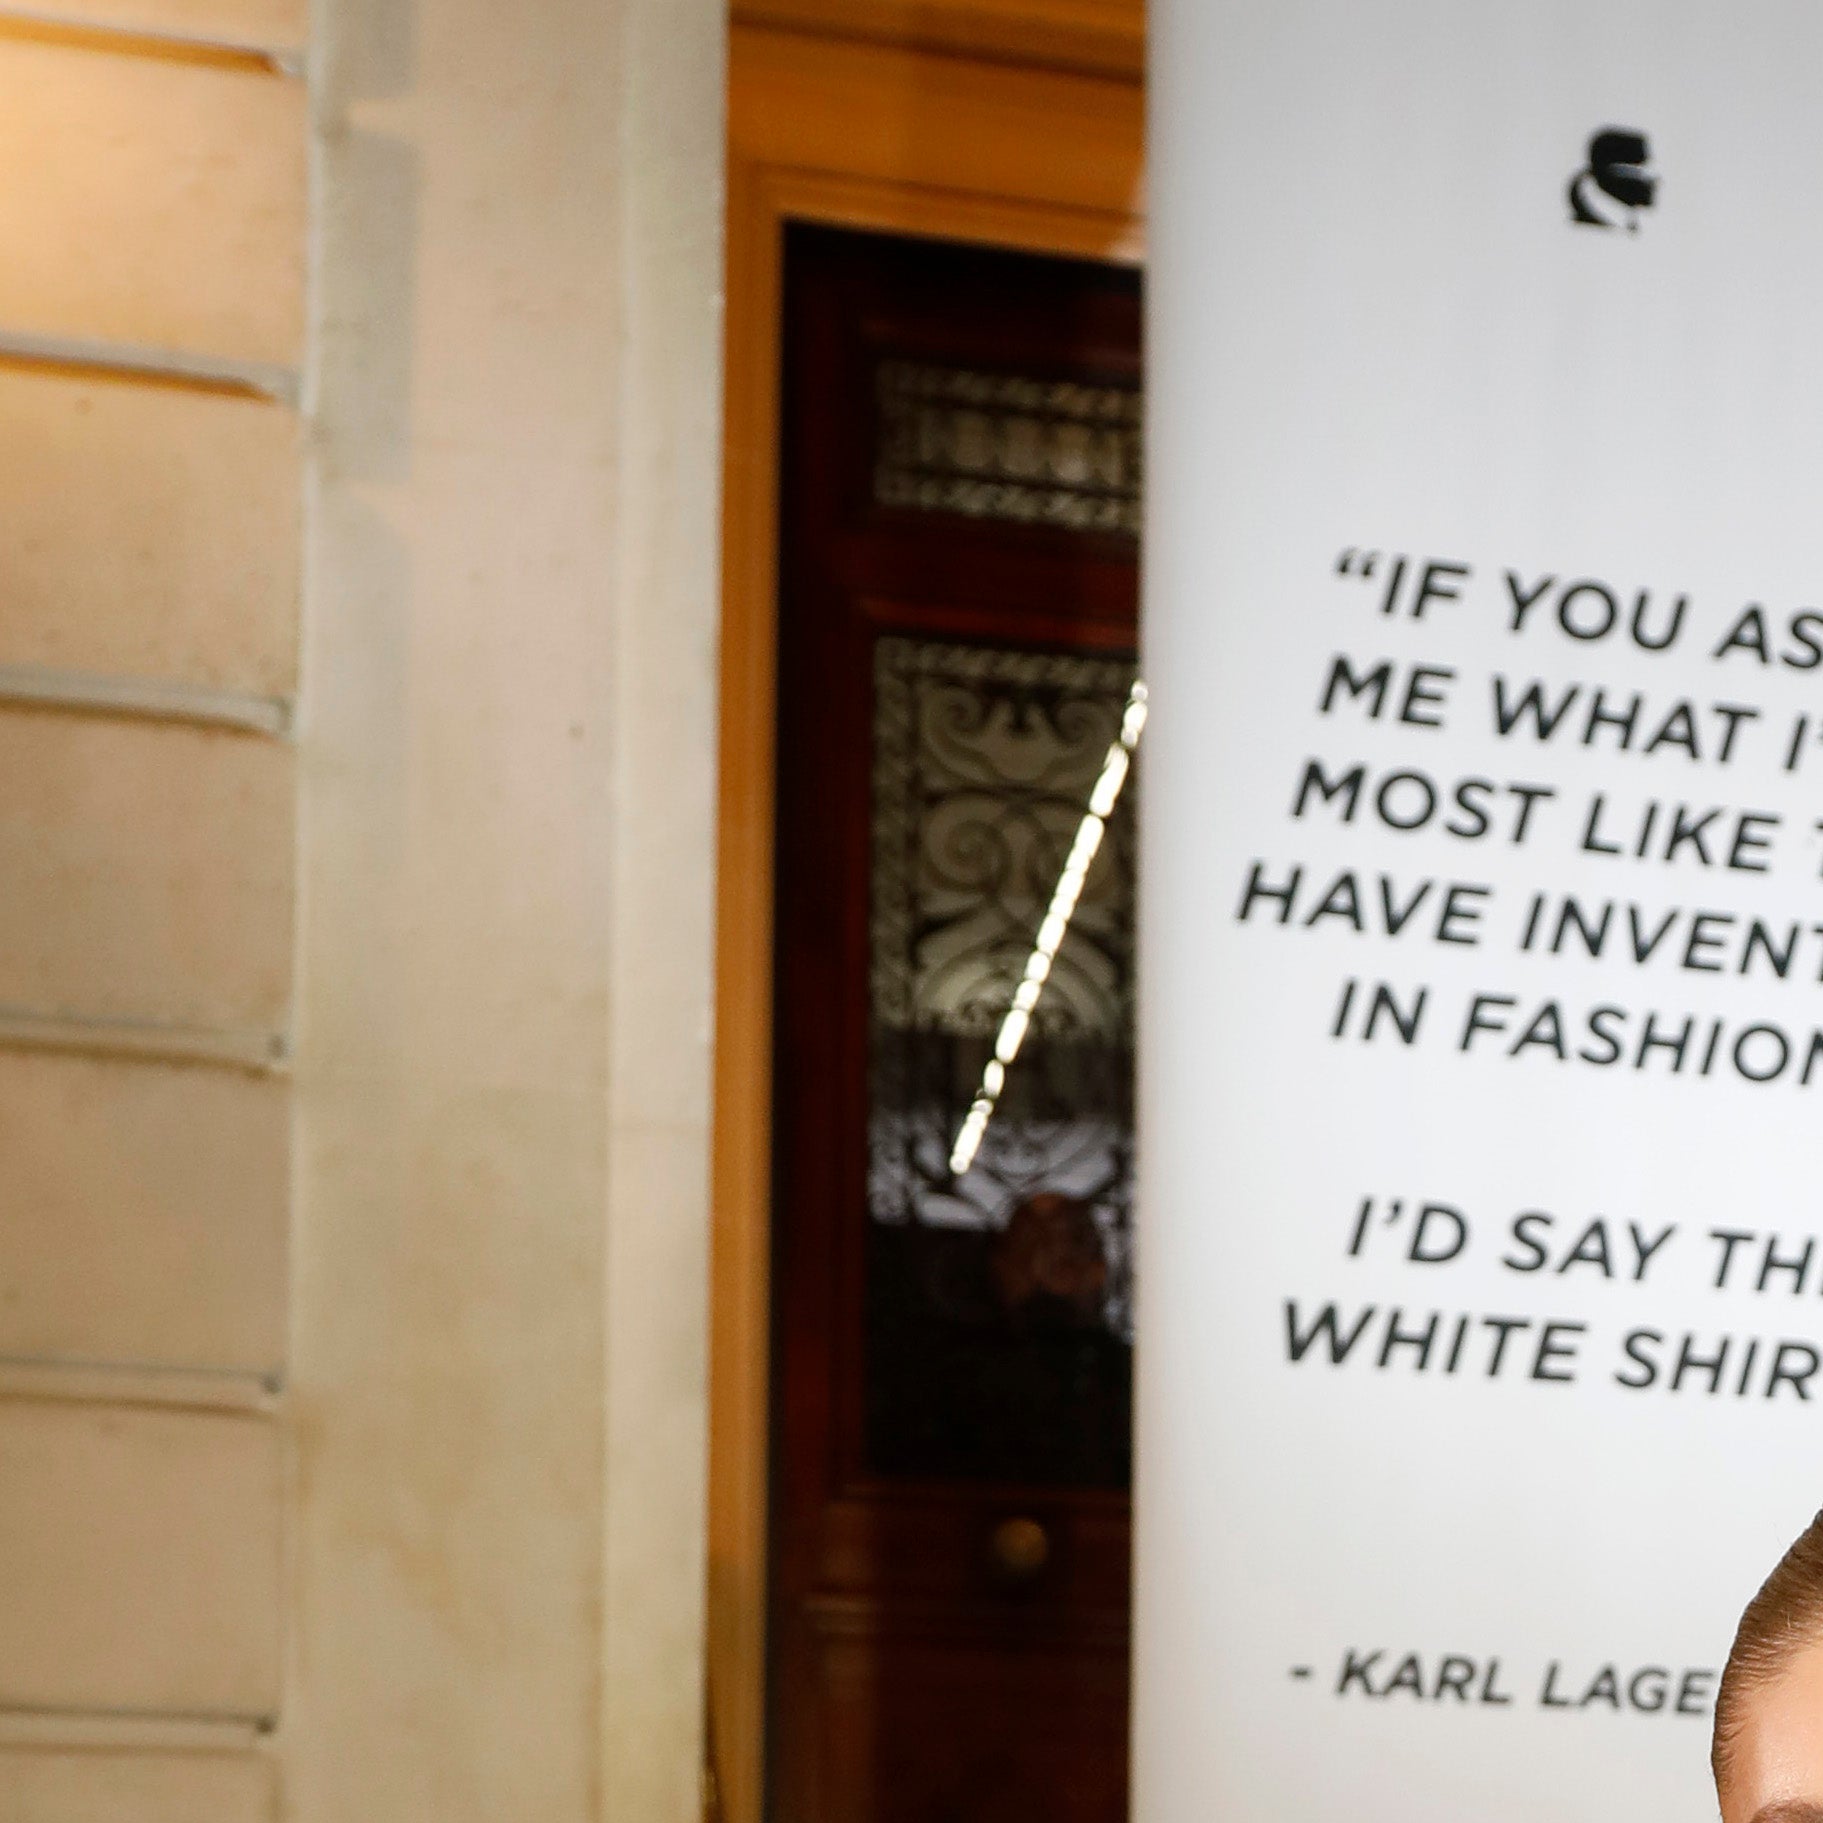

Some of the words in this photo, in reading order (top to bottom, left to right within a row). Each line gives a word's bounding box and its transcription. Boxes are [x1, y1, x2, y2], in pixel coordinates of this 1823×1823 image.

[1506, 572, 1688, 652] YOU
[1318, 655, 1457, 728] ME
[1491, 676, 1759, 763] WHAT
[1291, 759, 1556, 844] MOST
[1580, 796, 1780, 872] LIKE
[1236, 862, 1491, 945] HAVE
[1332, 980, 1428, 1046] IN
[1502, 1213, 1675, 1281] SAY
[1284, 1301, 1587, 1383] WHITE
[1335, 1650, 1511, 1706] KARL
[1539, 1664, 1716, 1716] LAGE
